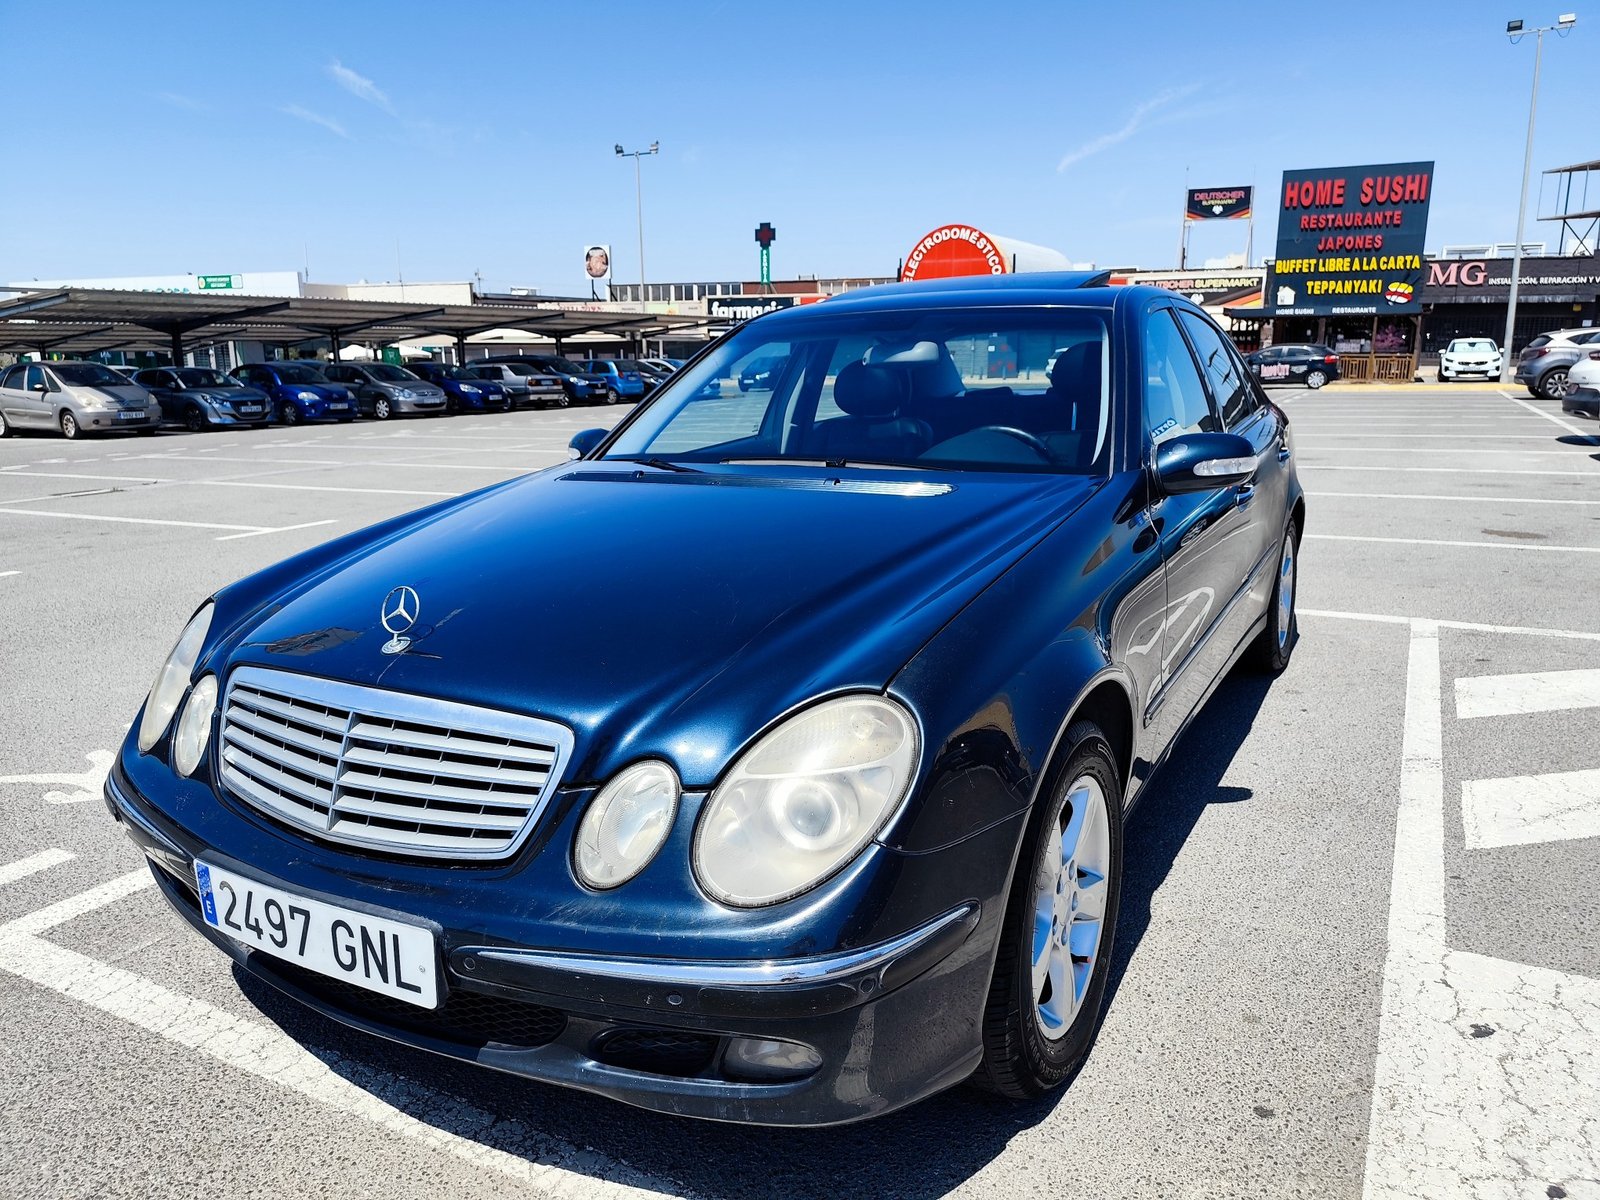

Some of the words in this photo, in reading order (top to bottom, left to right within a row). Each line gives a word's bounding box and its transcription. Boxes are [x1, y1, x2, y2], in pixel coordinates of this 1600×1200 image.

[1194, 191, 1245, 201] DEUTSCHER
[1284, 178, 1346, 208] HOME
[1360, 174, 1428, 204] SUSHI
[1300, 210, 1402, 230] RESTAURANTE
[1317, 234, 1383, 252] JAPONES
[1275, 258, 1317, 274] BUFFET
[1318, 257, 1351, 273] LIBRE
[1352, 257, 1361, 272] A
[1362, 256, 1378, 271] LA
[1379, 255, 1421, 270] CARTA
[1195, 278, 1259, 288] SUPERMARKT
[1426, 262, 1488, 286] MG
[1488, 276, 1538, 285] INSTALCIÓN,
[1588, 276, 1594, 284] Y
[1306, 279, 1383, 295] TEPPANYAKI
[711, 301, 784, 319] farmaci
[1331, 306, 1377, 314] RESTAURANTE
[206, 900, 213, 914] E
[219, 880, 311, 957] 2497
[331, 919, 422, 994] GNL
